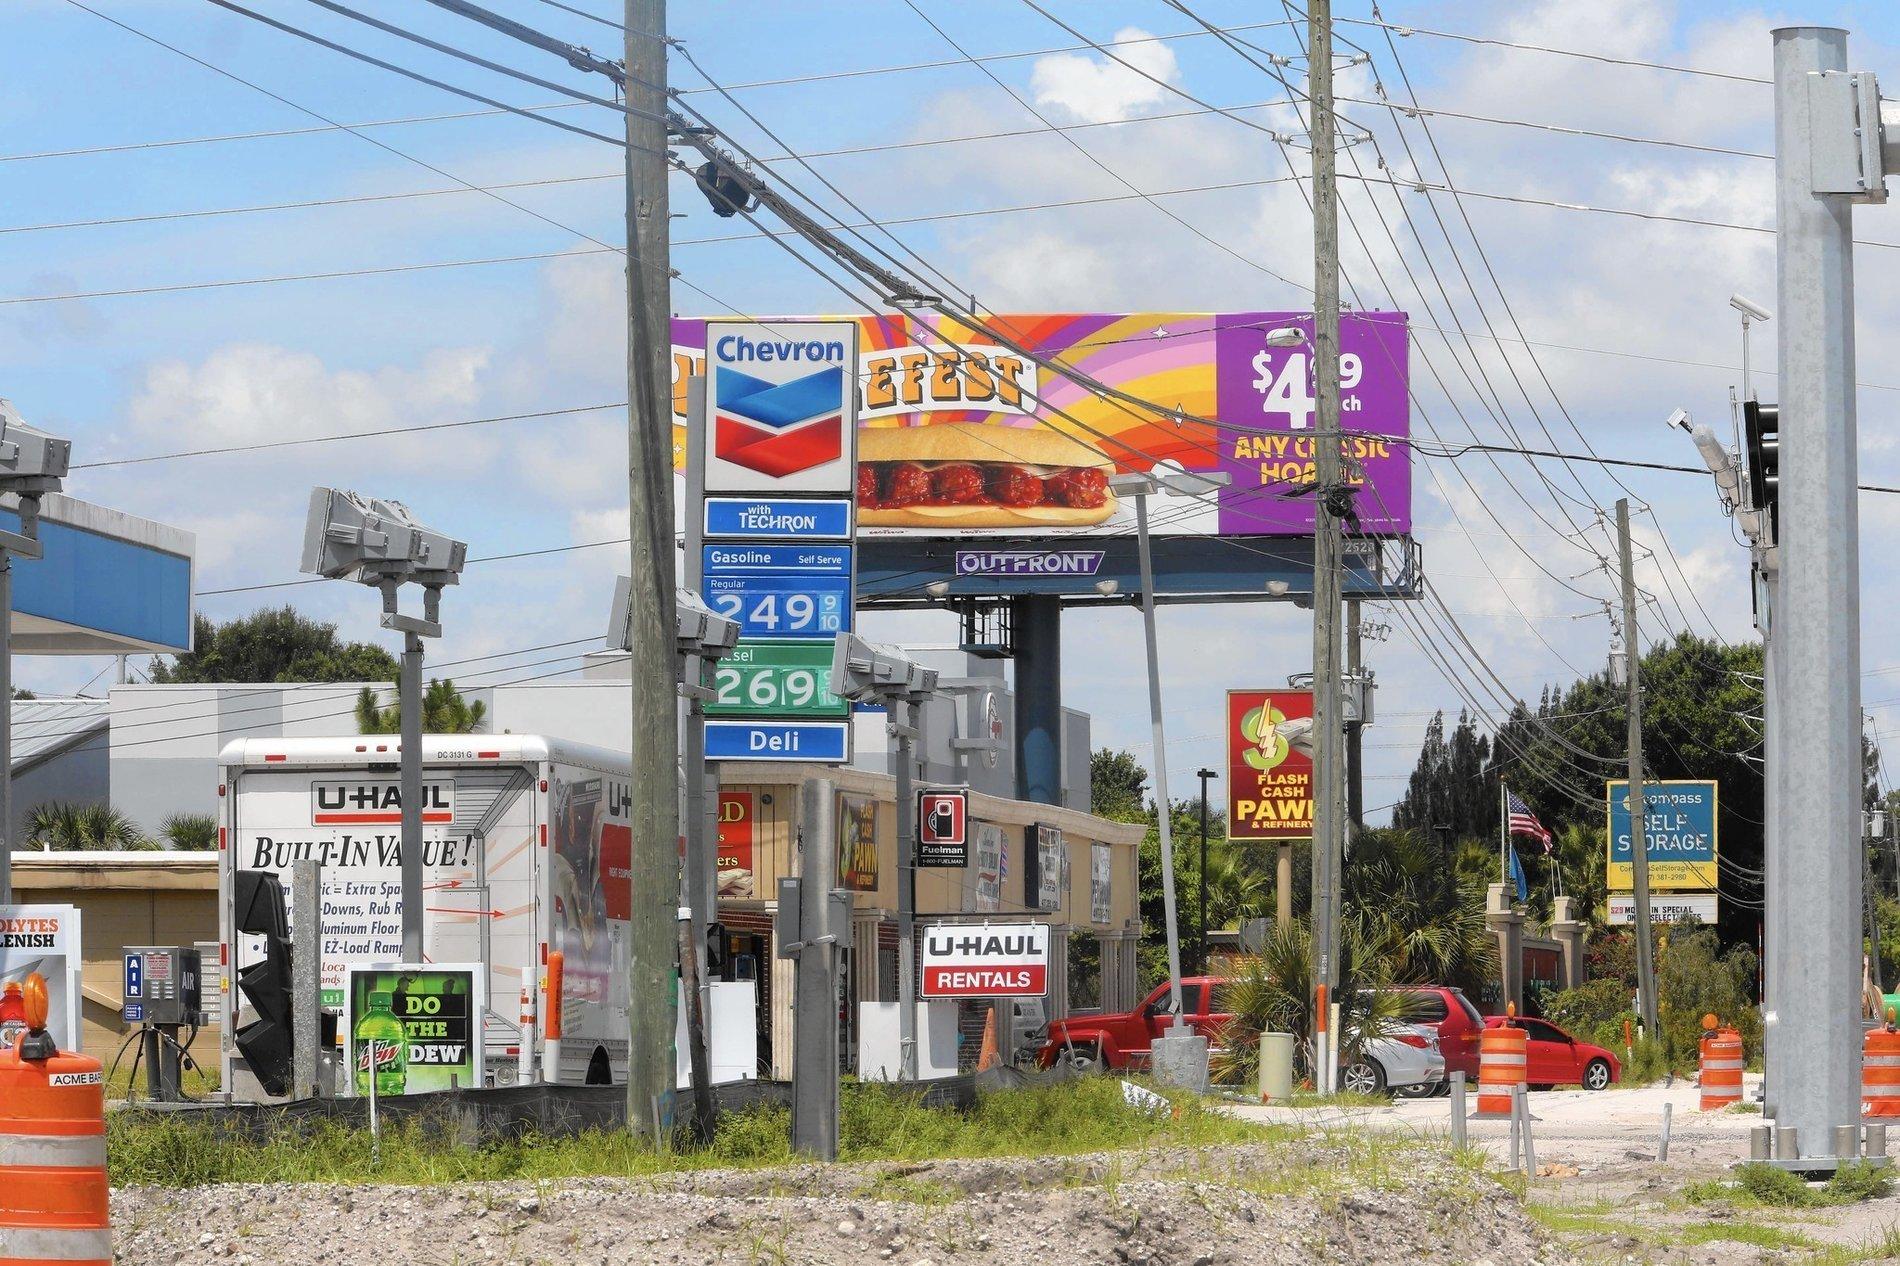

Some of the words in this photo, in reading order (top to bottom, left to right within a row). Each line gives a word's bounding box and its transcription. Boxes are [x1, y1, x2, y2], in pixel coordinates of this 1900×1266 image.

[716, 335, 844, 362] Chevron
[1234, 436, 1289, 458] ANY
[748, 505, 771, 515] with
[738, 512, 816, 532] TECHRON
[711, 551, 771, 564] Gasoline
[798, 555, 815, 564] Self
[817, 555, 842, 564] Serve
[961, 554, 1096, 573] OUTFRONT
[711, 579, 745, 589] Regular
[715, 594, 814, 630] 249
[721, 648, 753, 661] sel
[715, 668, 815, 707] 269
[750, 731, 799, 751] Deli
[438, 751, 448, 759] DC
[450, 751, 464, 759] 3131
[466, 751, 472, 759] G
[1257, 774, 1308, 785] FLASH
[318, 786, 450, 810] U-HAL
[1261, 787, 1304, 798] CASH
[1237, 800, 1314, 821] PAW
[374, 834, 472, 868] VAUE!
[922, 845, 963, 854] Fuelman
[1618, 833, 1708, 851] SORAGE
[853, 842, 878, 873] PAWN
[345, 882, 376, 896] Extra
[380, 881, 402, 899] Spa
[369, 901, 390, 915] Rub
[1662, 906, 1693, 914] SPECIAL
[321, 920, 367, 935] luminum
[371, 920, 400, 935] Floor
[129, 959, 139, 995] AIR
[181, 971, 195, 991] AIR
[937, 971, 1031, 989] RENTALS
[405, 996, 442, 1015] DO
[406, 1021, 448, 1037] THE
[408, 1044, 462, 1063] DEW
[54, 1073, 87, 1086] ACME
